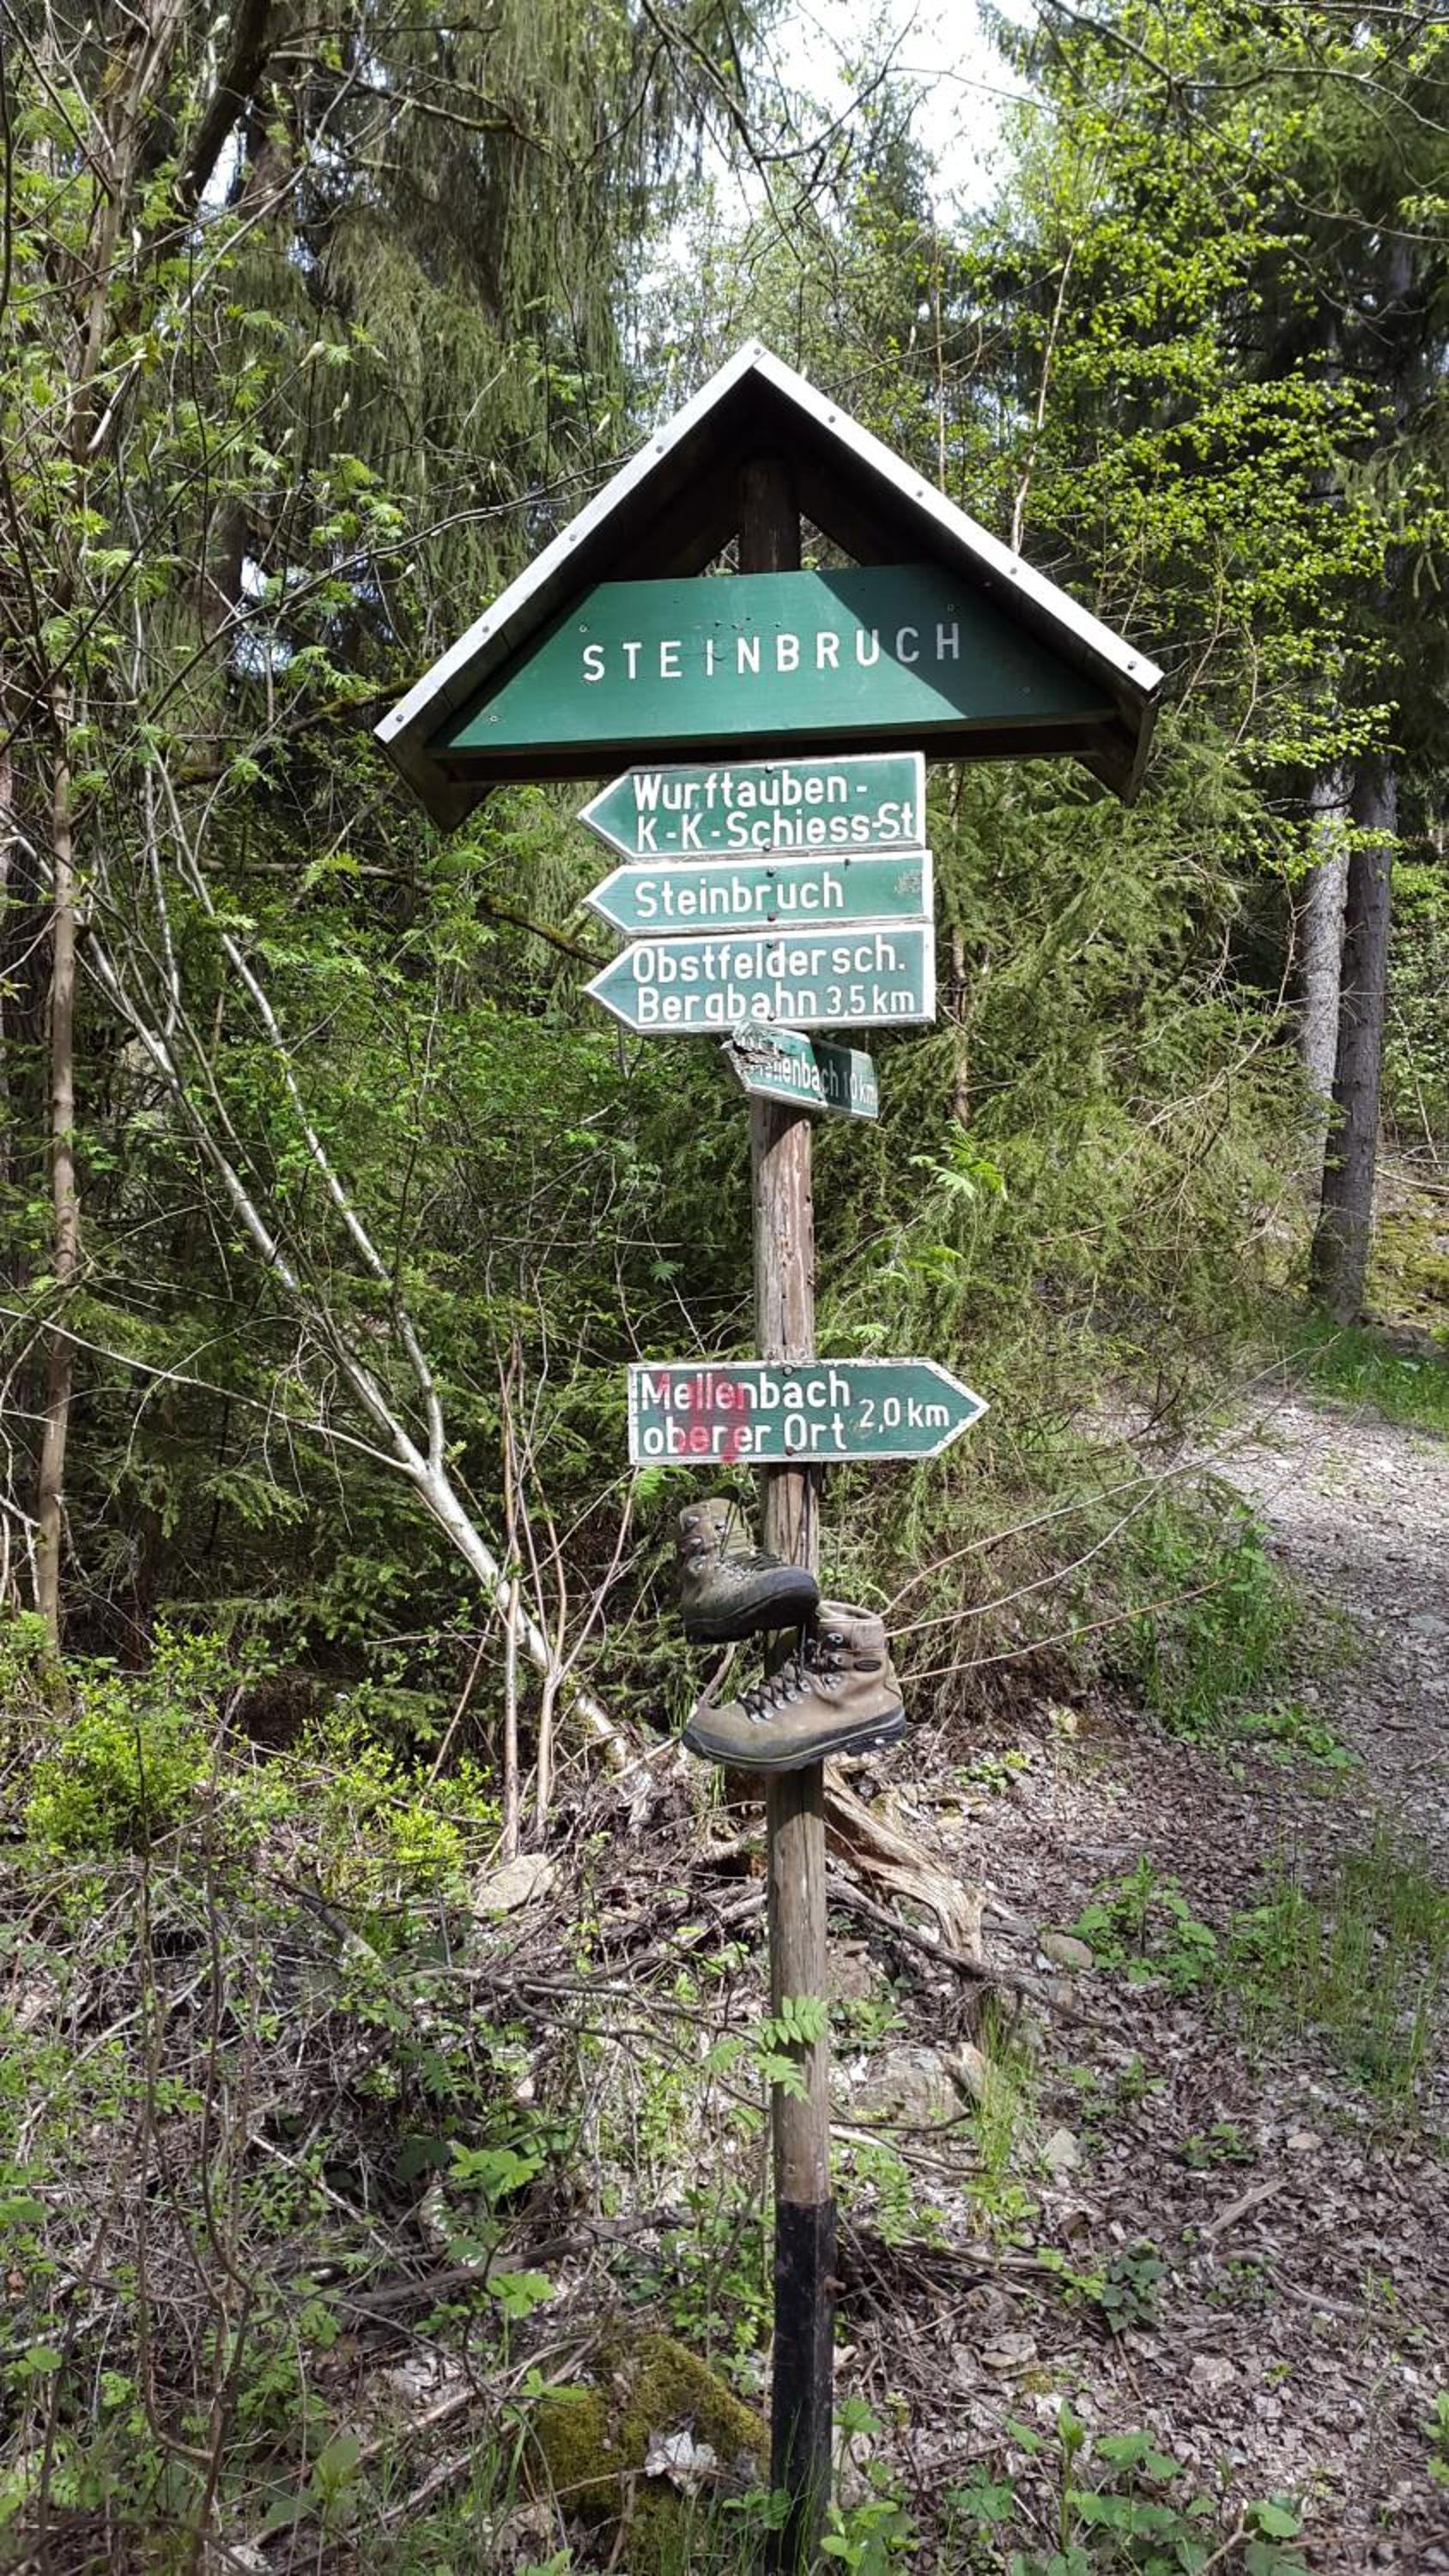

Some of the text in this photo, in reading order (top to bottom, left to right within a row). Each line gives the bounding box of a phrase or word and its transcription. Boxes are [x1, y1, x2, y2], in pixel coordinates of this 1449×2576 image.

[582, 622, 960, 683] STEINBRUCH
[633, 769, 869, 812] Wurftauben-
[634, 872, 845, 918] Steinbruch
[637, 981, 915, 1024] Bergbahn 3,5 km
[641, 1370, 850, 1411] Mellenbach
[643, 1413, 847, 1455] oberer Ort
[858, 1397, 949, 1433] 2,0 km
